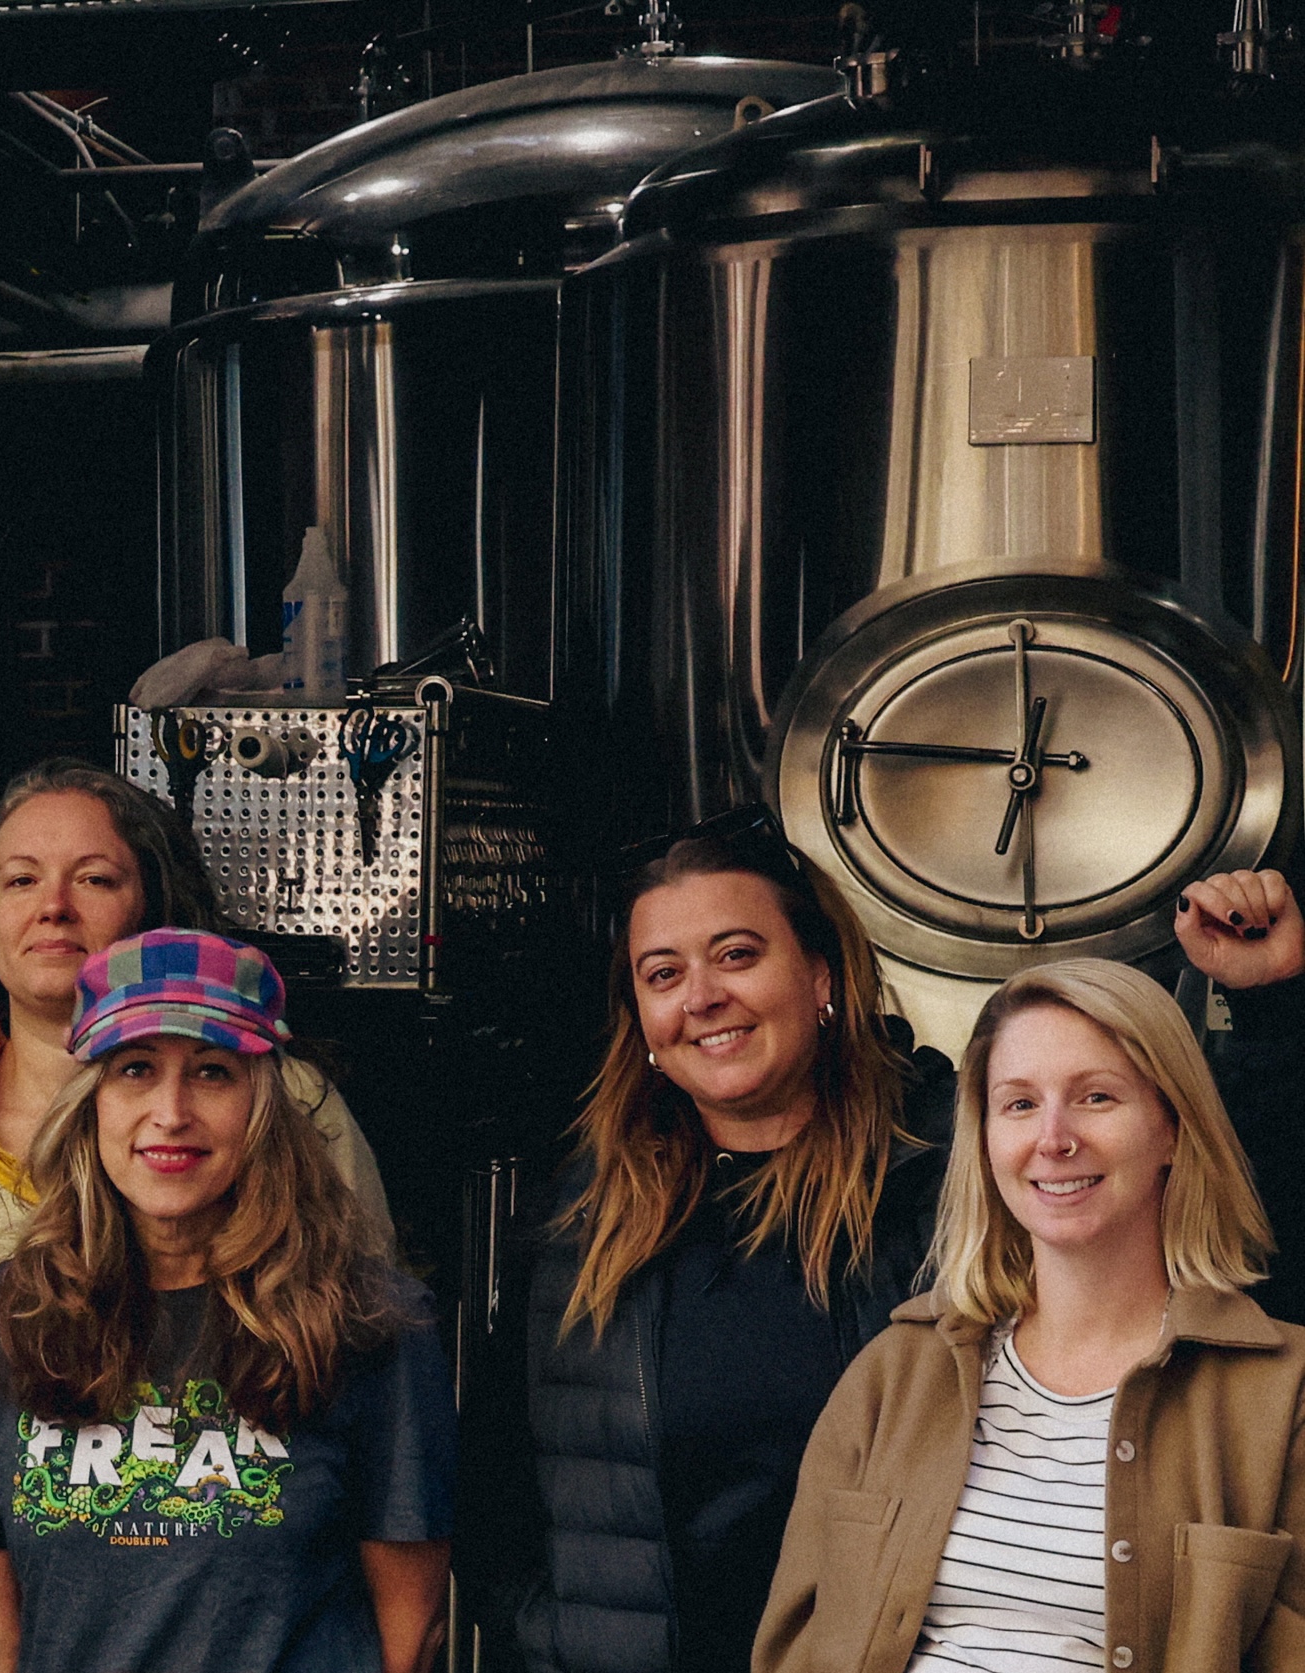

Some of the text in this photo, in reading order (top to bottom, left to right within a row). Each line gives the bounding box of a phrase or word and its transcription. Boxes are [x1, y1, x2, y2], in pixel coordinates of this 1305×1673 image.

[92, 1518, 198, 1537] of NATURE
[110, 1536, 169, 1546] DOUBLE IPA
